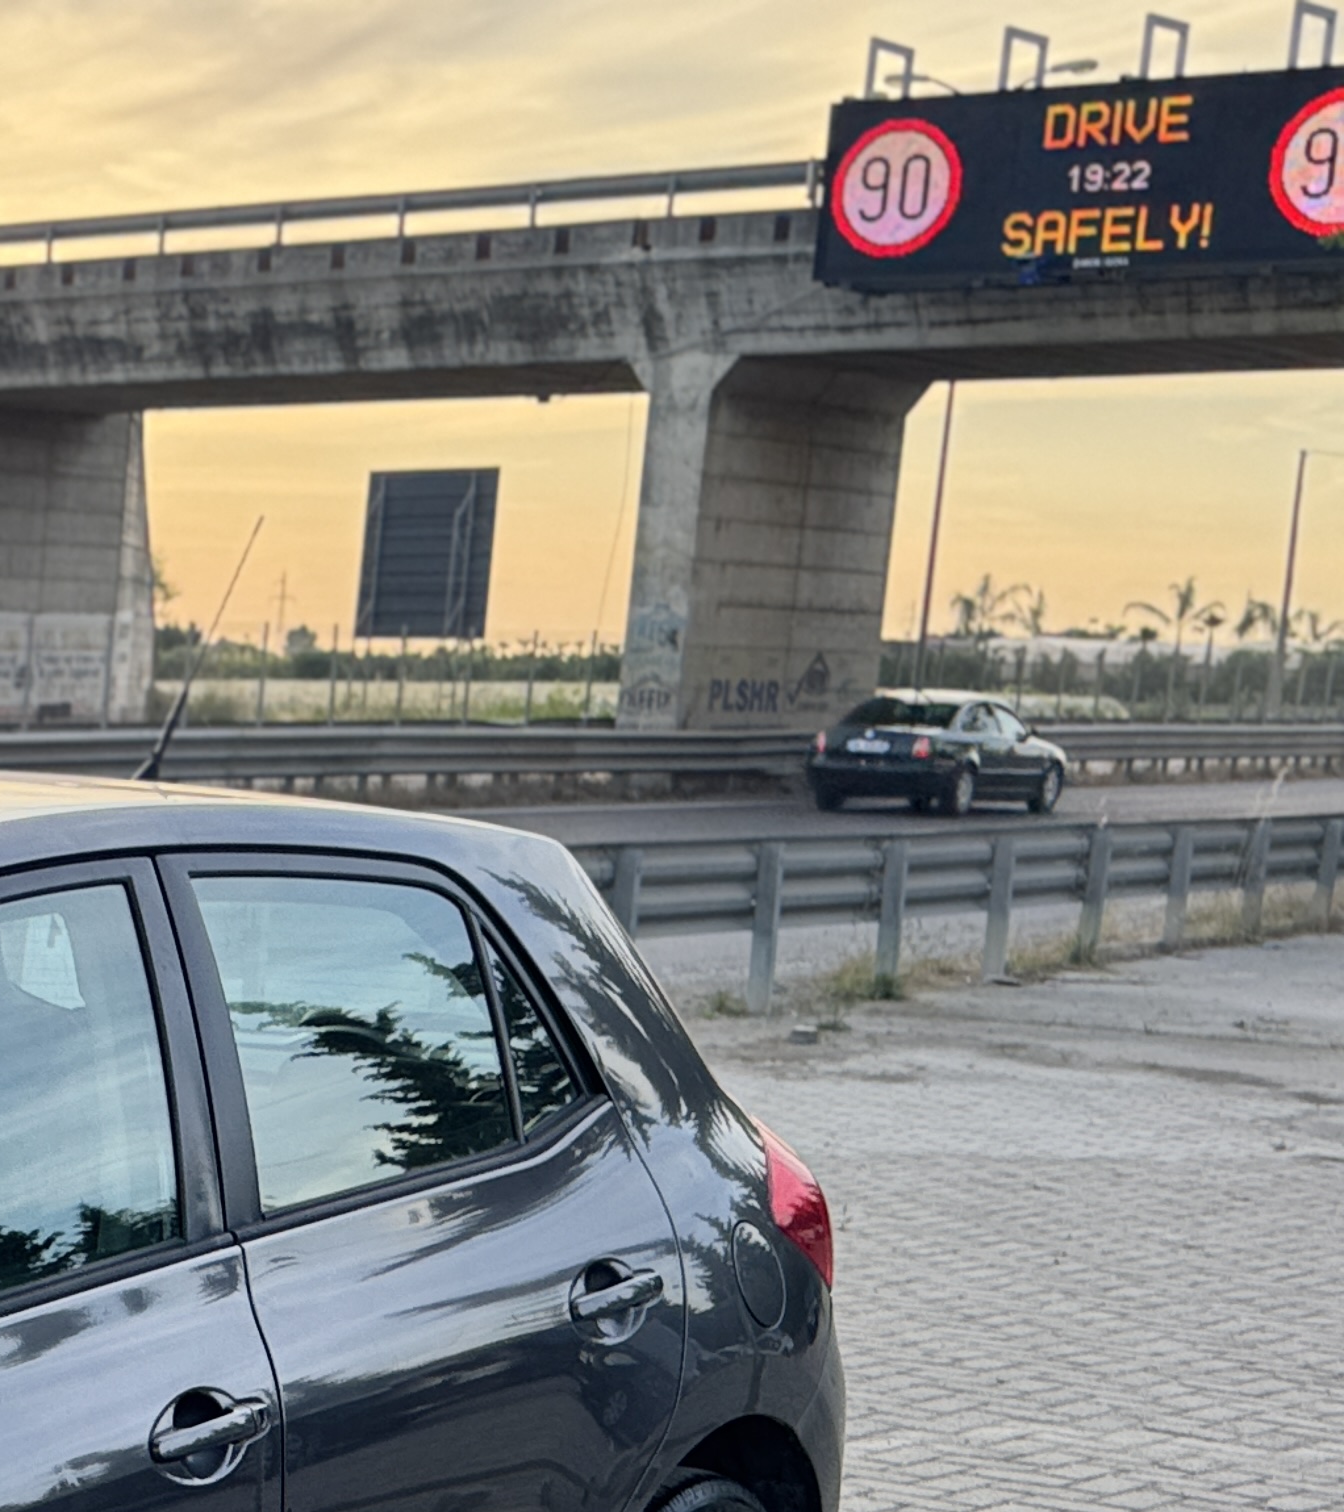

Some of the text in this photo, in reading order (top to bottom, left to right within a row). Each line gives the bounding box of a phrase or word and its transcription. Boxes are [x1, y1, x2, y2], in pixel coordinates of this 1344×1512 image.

[1044, 96, 1192, 149] DRIVE
[860, 155, 930, 222] 90
[1067, 161, 1152, 193] 19:22
[1001, 203, 1213, 257] SAFELY!
